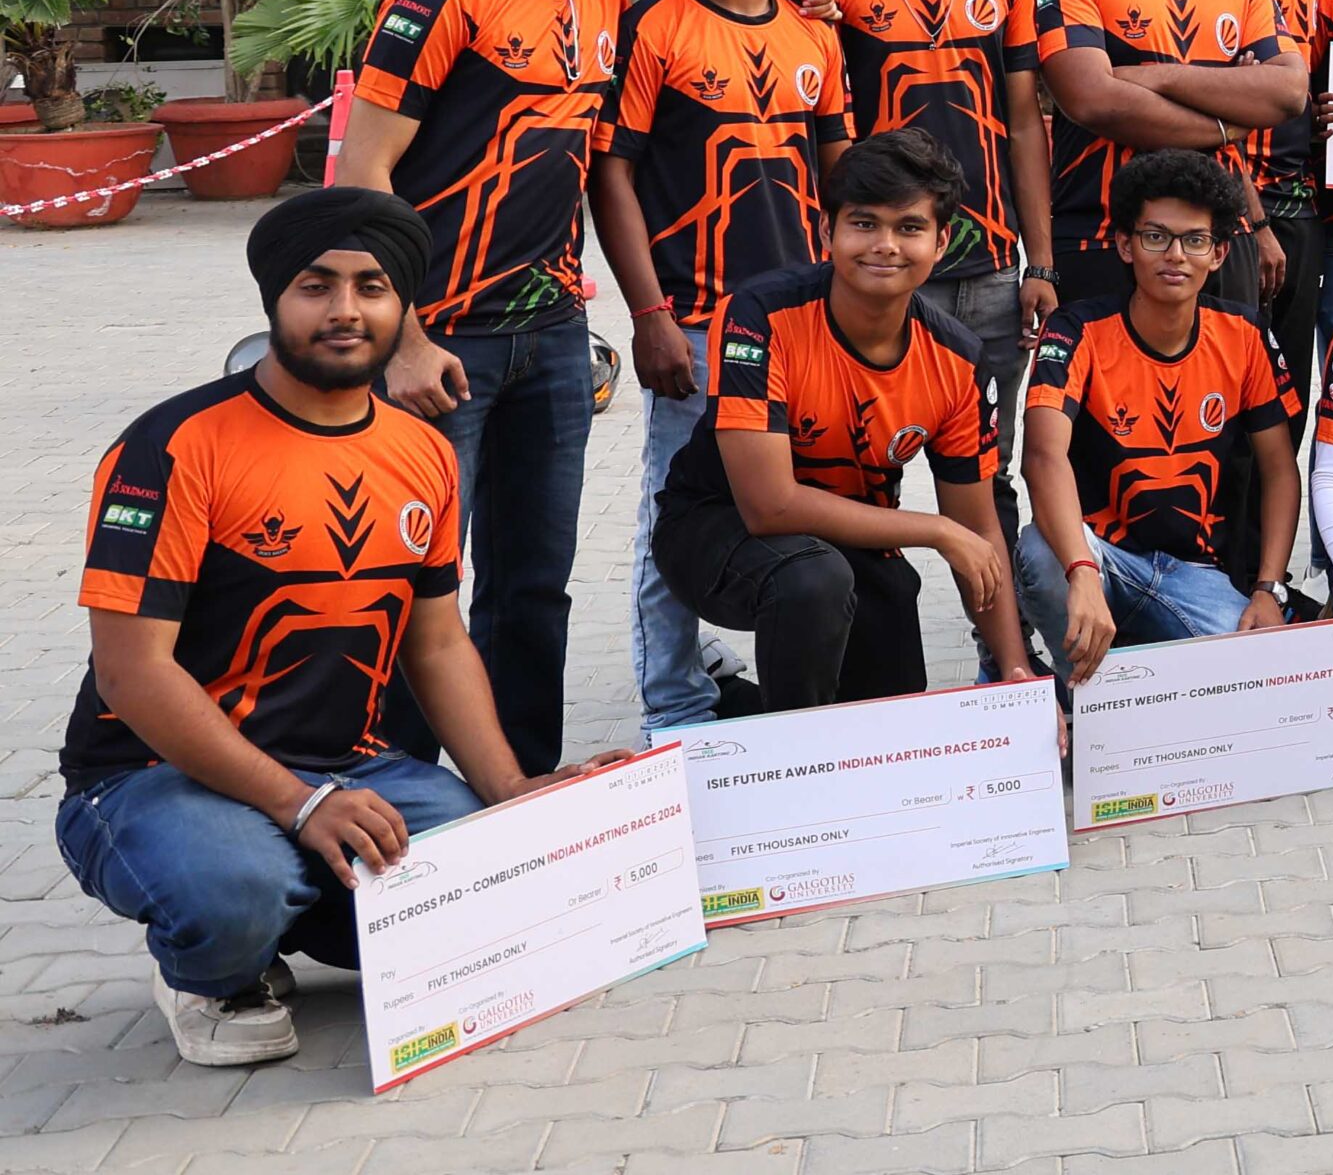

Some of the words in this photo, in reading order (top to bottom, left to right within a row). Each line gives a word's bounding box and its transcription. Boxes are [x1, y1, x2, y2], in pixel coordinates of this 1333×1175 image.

[386, 15, 422, 35] BKT
[726, 345, 763, 359] BKT
[105, 507, 152, 524] BKT
[1080, 698, 1133, 714] LIGHTEST
[1135, 692, 1179, 707] WEIGHT
[1189, 679, 1263, 698] COMBUSTION
[1265, 674, 1302, 687] INDIAN
[707, 777, 731, 790] ISIE
[733, 769, 782, 788] FUTURE
[785, 762, 835, 780] AWARD
[838, 754, 883, 770] INDIAN
[886, 746, 942, 765] KARTING
[944, 740, 977, 755] RACE
[980, 736, 1010, 750] 2024
[1133, 755, 1153, 766] FIVE
[1155, 748, 1207, 763] THOUSAND
[1209, 743, 1233, 755] ONLY
[987, 778, 1021, 795] 5,000
[1177, 782, 1234, 799] GALGOTIAS
[731, 844, 754, 856] FIVE
[757, 835, 818, 853] THOUSAND
[821, 829, 849, 843] ONLY
[369, 915, 396, 934] BEST
[398, 898, 437, 922] CROSS
[439, 888, 462, 907] PAD
[473, 856, 545, 893] COMBUSTION
[547, 842, 583, 864] INDIAN
[585, 824, 629, 850] KARTING
[630, 815, 657, 832] RACE
[659, 803, 682, 823] 2024
[630, 862, 658, 883] 5,000
[788, 872, 855, 892] GALGOTIAS
[728, 893, 759, 906] INDIA
[428, 976, 448, 991] FIVE
[450, 953, 502, 985] THOUSAND
[503, 942, 527, 962] ONLY
[478, 990, 534, 1022] GALGOTIAS
[428, 1030, 455, 1048] INDIA
